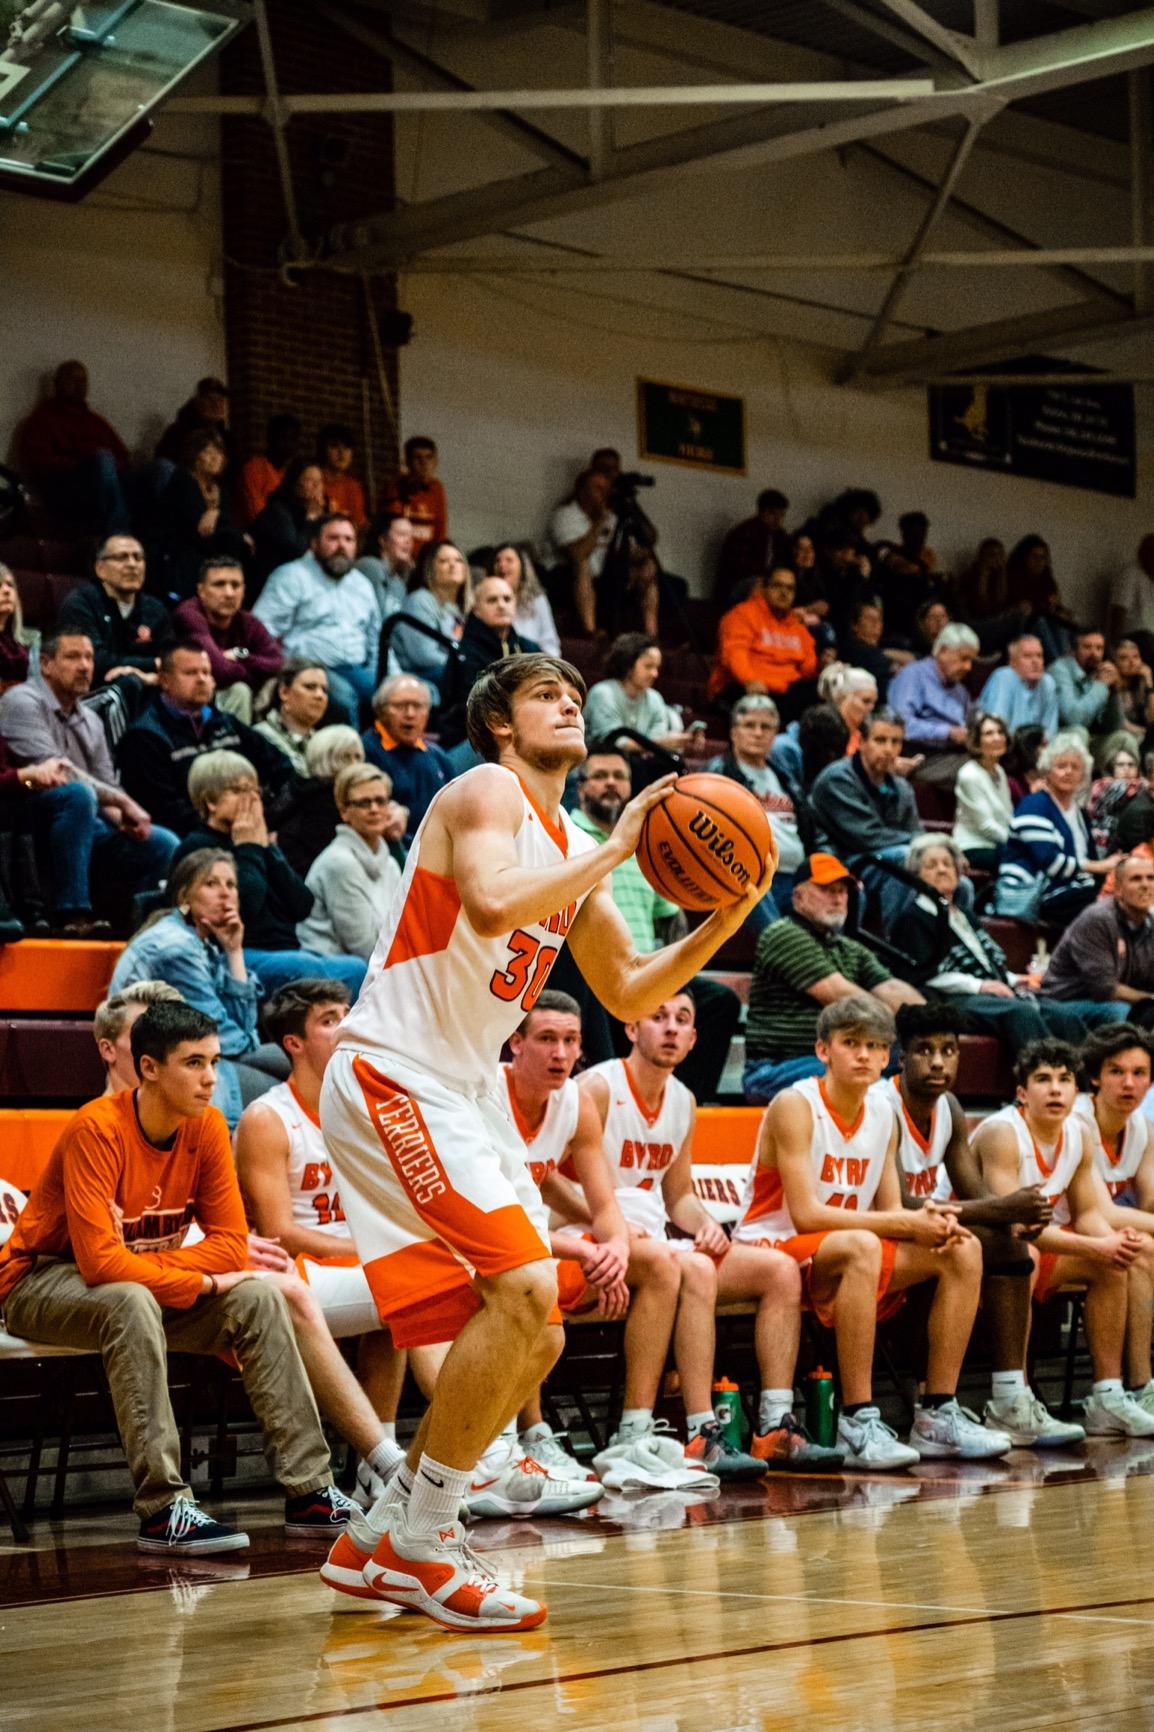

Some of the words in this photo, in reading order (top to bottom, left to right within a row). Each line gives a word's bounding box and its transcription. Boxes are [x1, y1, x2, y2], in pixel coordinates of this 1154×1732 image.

[689, 810, 751, 887] Wilson
[490, 929, 557, 1012] 30
[375, 1093, 446, 1204] TERRIERS
[619, 1139, 673, 1170] BYRD
